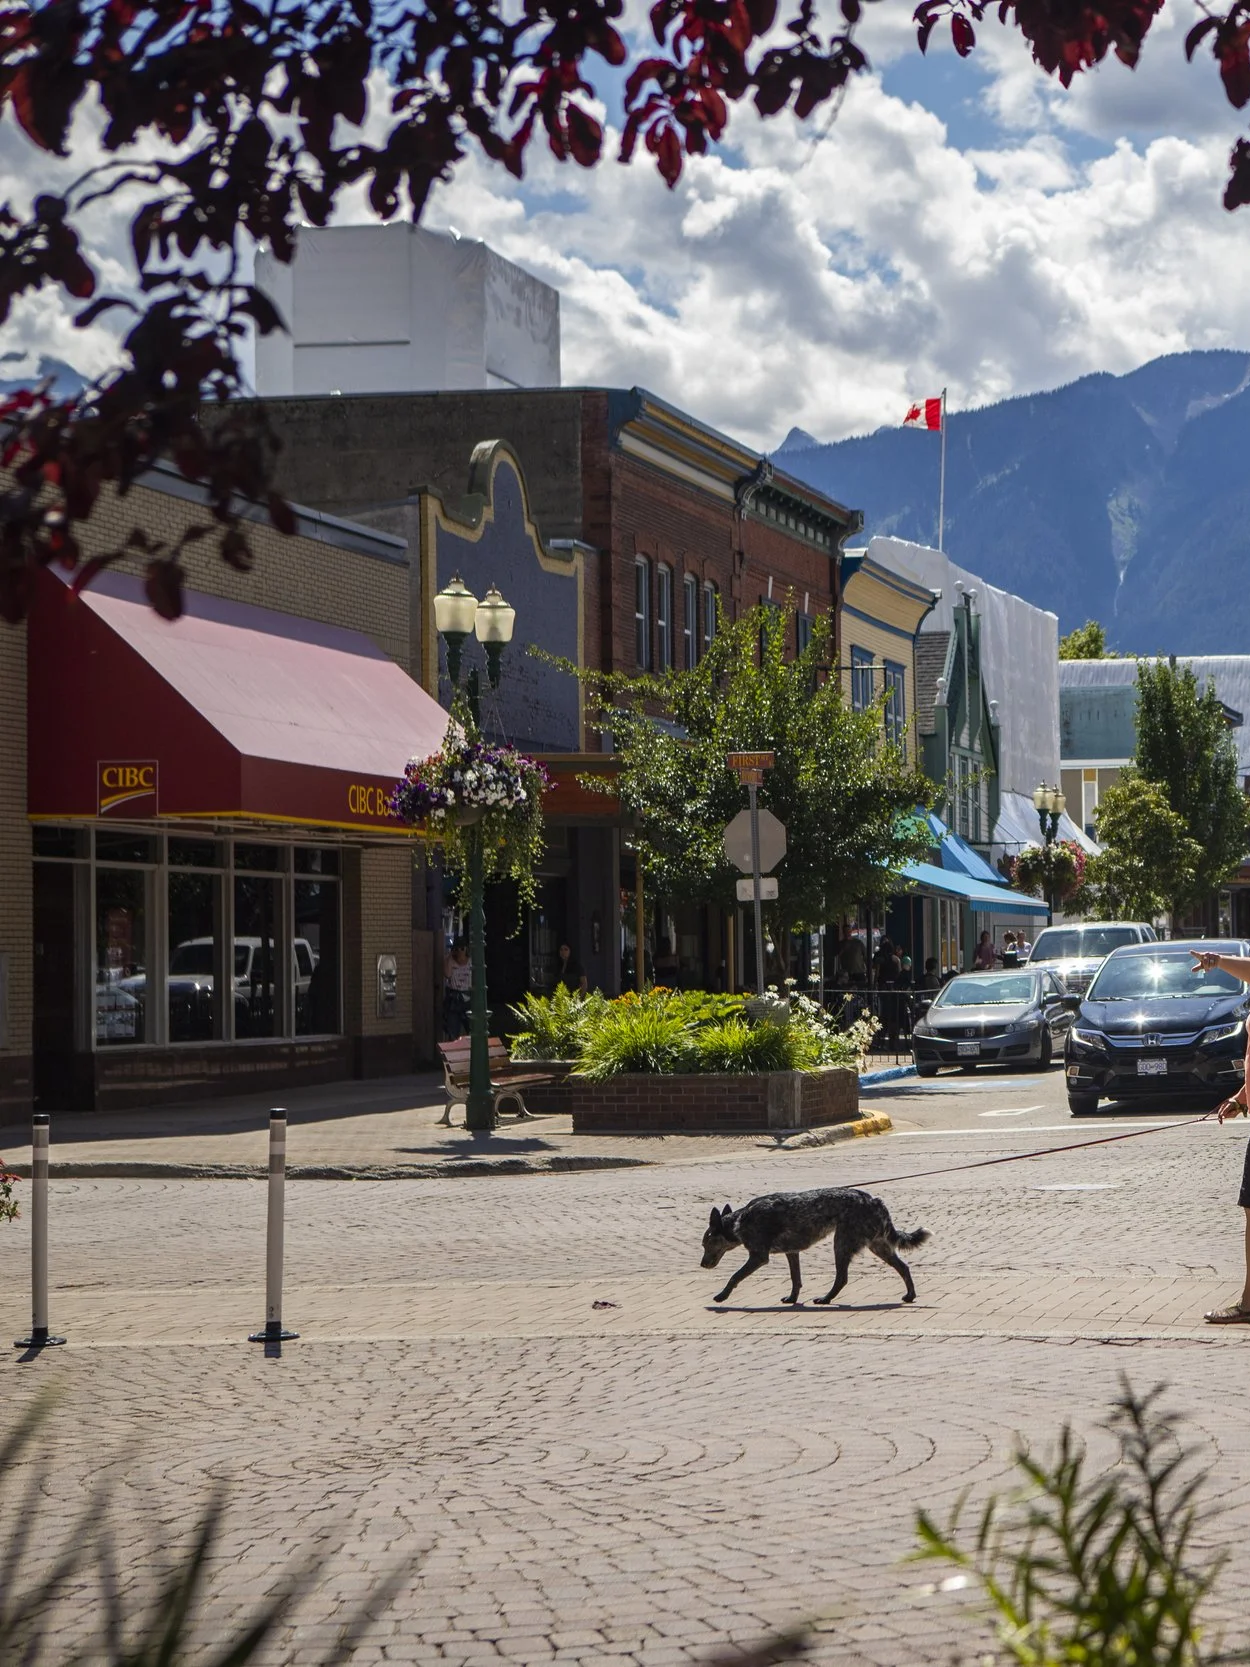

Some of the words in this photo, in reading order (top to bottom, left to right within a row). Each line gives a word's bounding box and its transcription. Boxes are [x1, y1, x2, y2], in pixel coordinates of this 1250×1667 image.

[732, 755, 760, 767] FIRST
[102, 767, 154, 788] CIBC
[348, 784, 374, 816] CIBC
